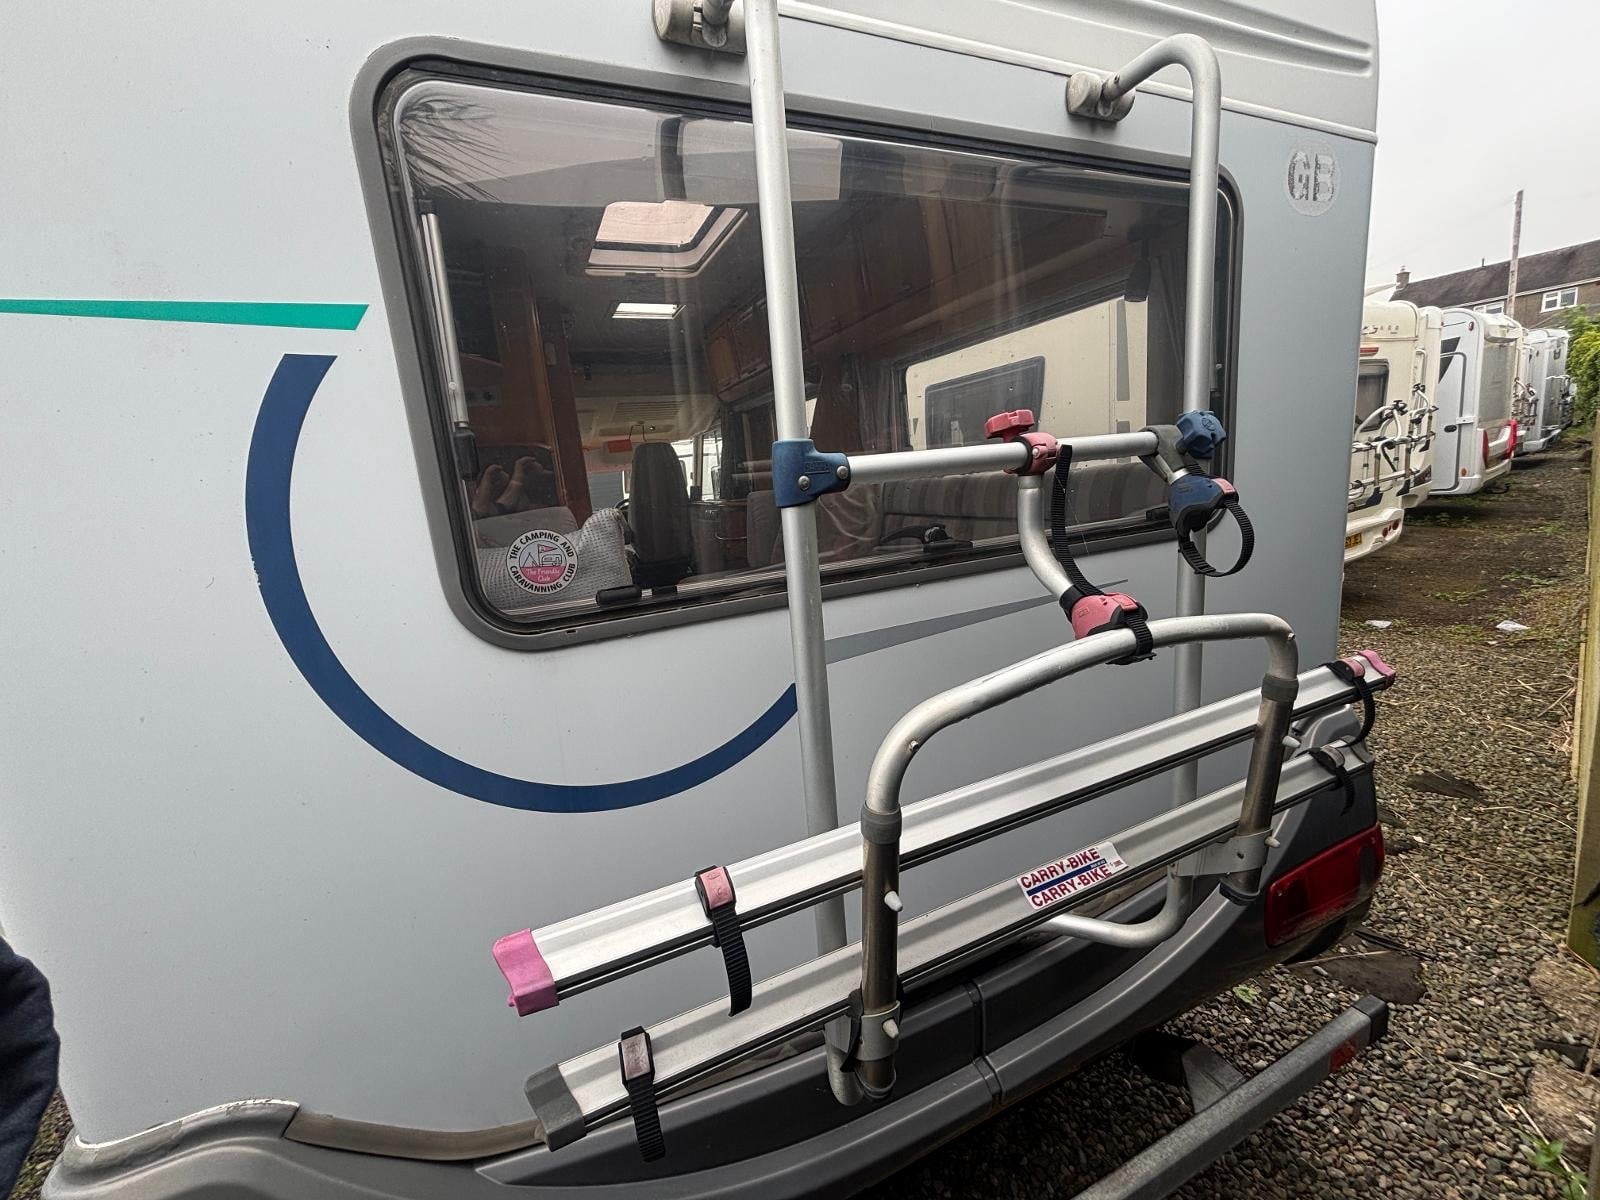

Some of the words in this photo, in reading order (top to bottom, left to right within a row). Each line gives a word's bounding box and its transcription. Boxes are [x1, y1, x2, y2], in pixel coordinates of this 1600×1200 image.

[1287, 152, 1335, 201] GB
[509, 544, 521, 560] THE
[520, 531, 560, 545] CAMPING
[560, 541, 574, 558] AND
[510, 565, 563, 593] CARAVANNING
[563, 563, 576, 582] CLUB
[1020, 847, 1101, 889] CARRY-BIKE
[1031, 865, 1112, 907] CARRY-BIKE
